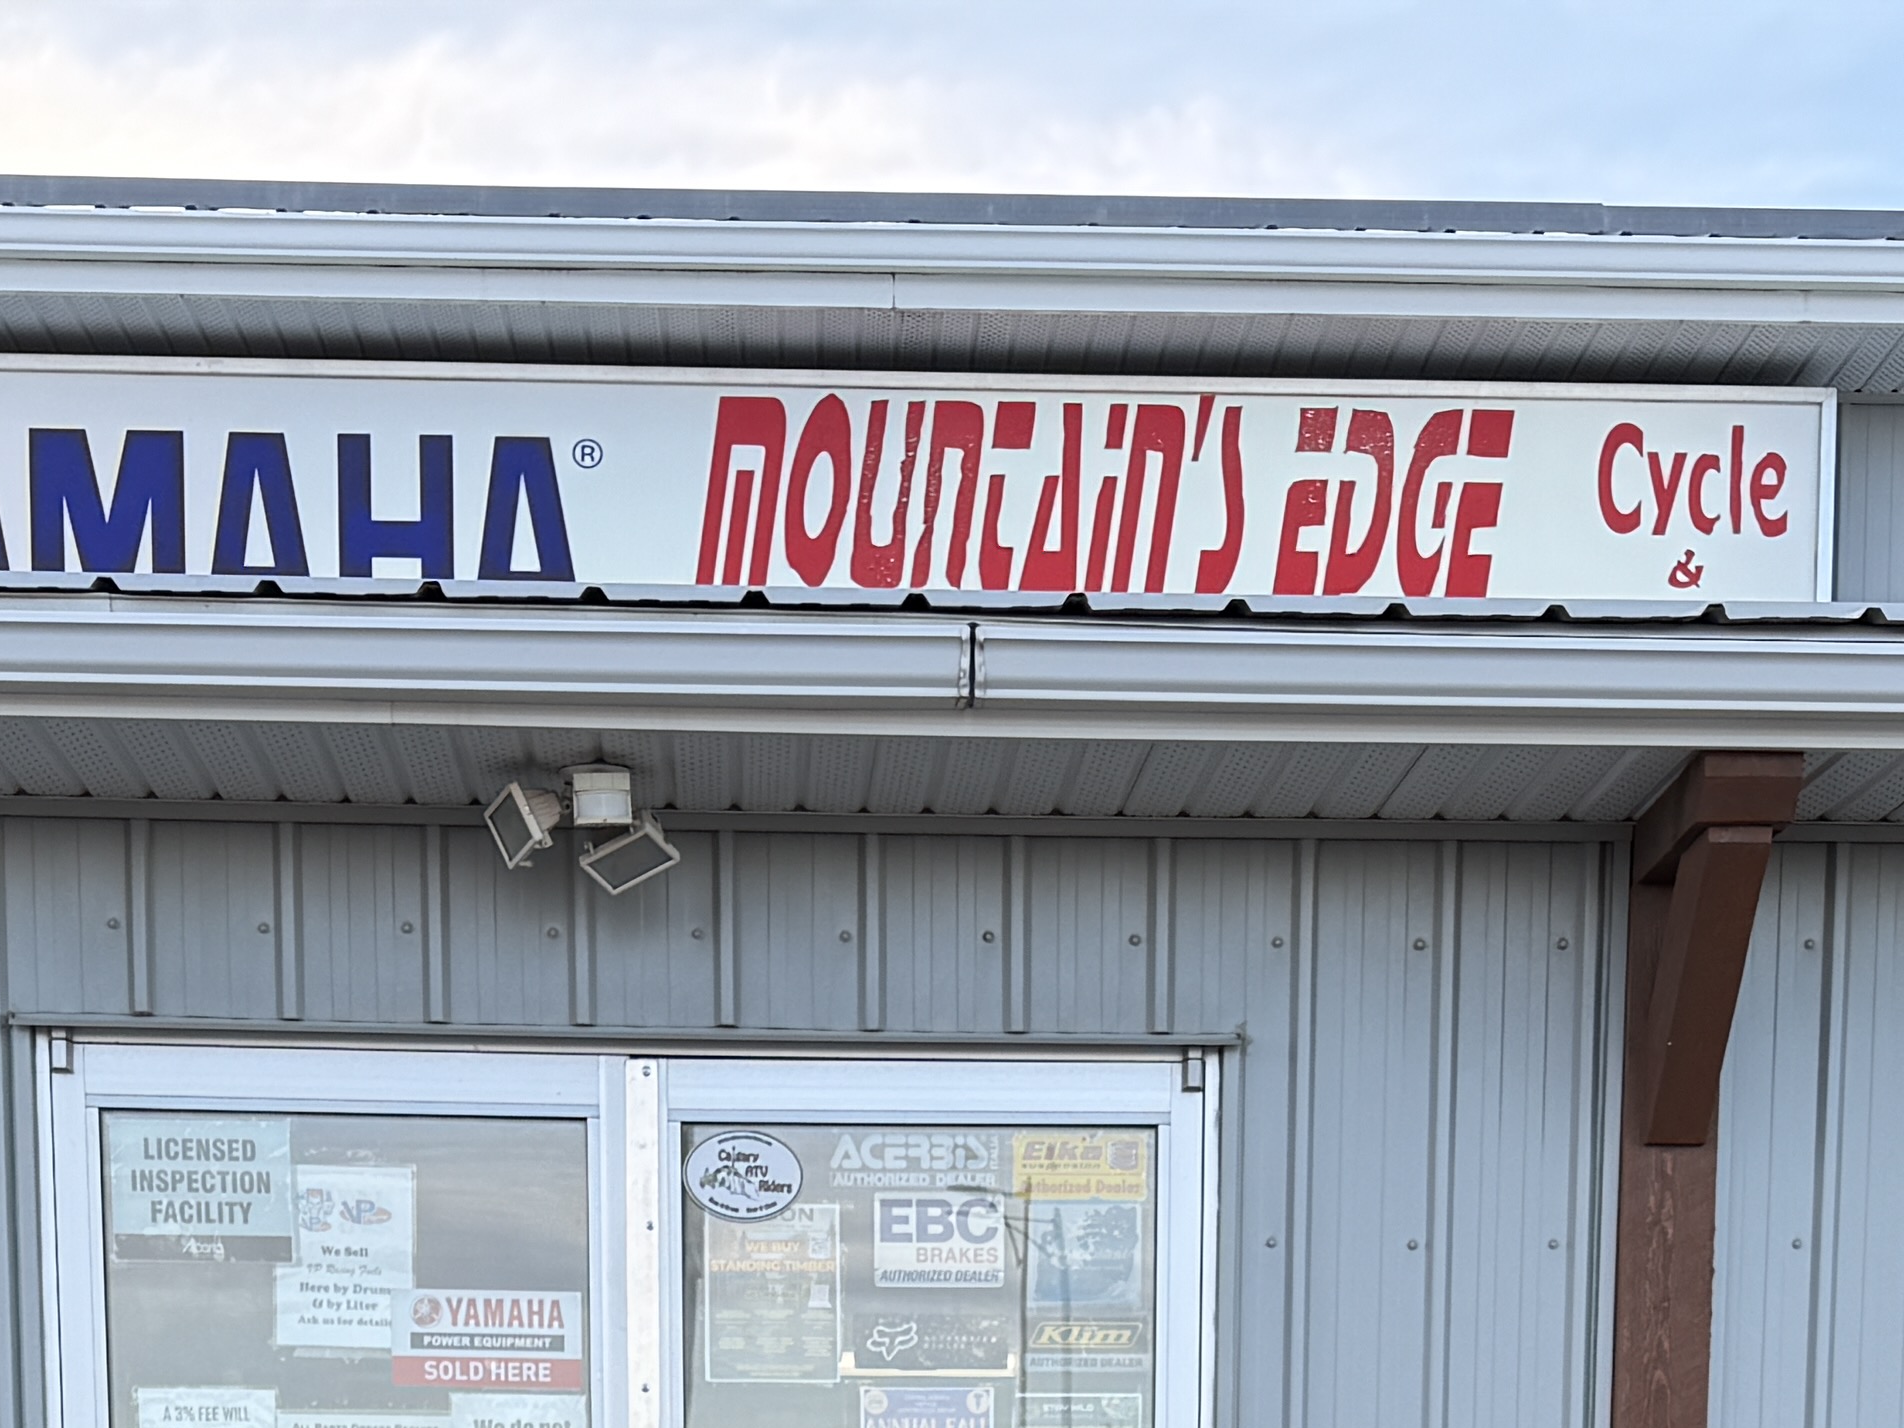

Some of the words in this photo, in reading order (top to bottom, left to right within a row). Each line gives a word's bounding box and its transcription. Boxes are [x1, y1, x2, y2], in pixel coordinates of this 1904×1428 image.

[1597, 421, 1790, 537] Cycle
[695, 391, 1246, 594] MOUNTAIN'S
[1273, 405, 1516, 599] EDGE
[1665, 548, 1704, 589] &
[143, 1137, 257, 1162] LICENSED
[830, 1133, 989, 1170] ACERBIS
[746, 1165, 769, 1178] ATV
[832, 1172, 930, 1187] AUTHORIZED
[936, 1173, 997, 1187] DEALER
[130, 1169, 272, 1195] INSPECTION
[150, 1200, 253, 1225] FACILITY
[879, 1197, 1000, 1245] EBC
[320, 1245, 341, 1258] We
[345, 1246, 370, 1258] Sell
[771, 1241, 800, 1253] BUY
[915, 1246, 1000, 1265] BRAKES
[710, 1260, 782, 1272] STANDING
[783, 1260, 836, 1273] TIMBER
[879, 1269, 954, 1283] AUTHORIZED
[954, 1270, 1000, 1283] DEALER
[333, 1284, 349, 1296] by
[326, 1299, 343, 1312] by
[445, 1296, 565, 1329] YAMAHA
[422, 1335, 471, 1348] POWER
[473, 1336, 553, 1349] EQUIPMENT
[1029, 1356, 1097, 1368] AUTHORIZED
[1099, 1357, 1144, 1368] DEALER
[424, 1360, 485, 1382] SOLD
[490, 1361, 553, 1383] HERE
[162, 1406, 172, 1422] A
[175, 1406, 196, 1422] 3%
[198, 1406, 220, 1422] FEE
[222, 1406, 251, 1422] WILL
